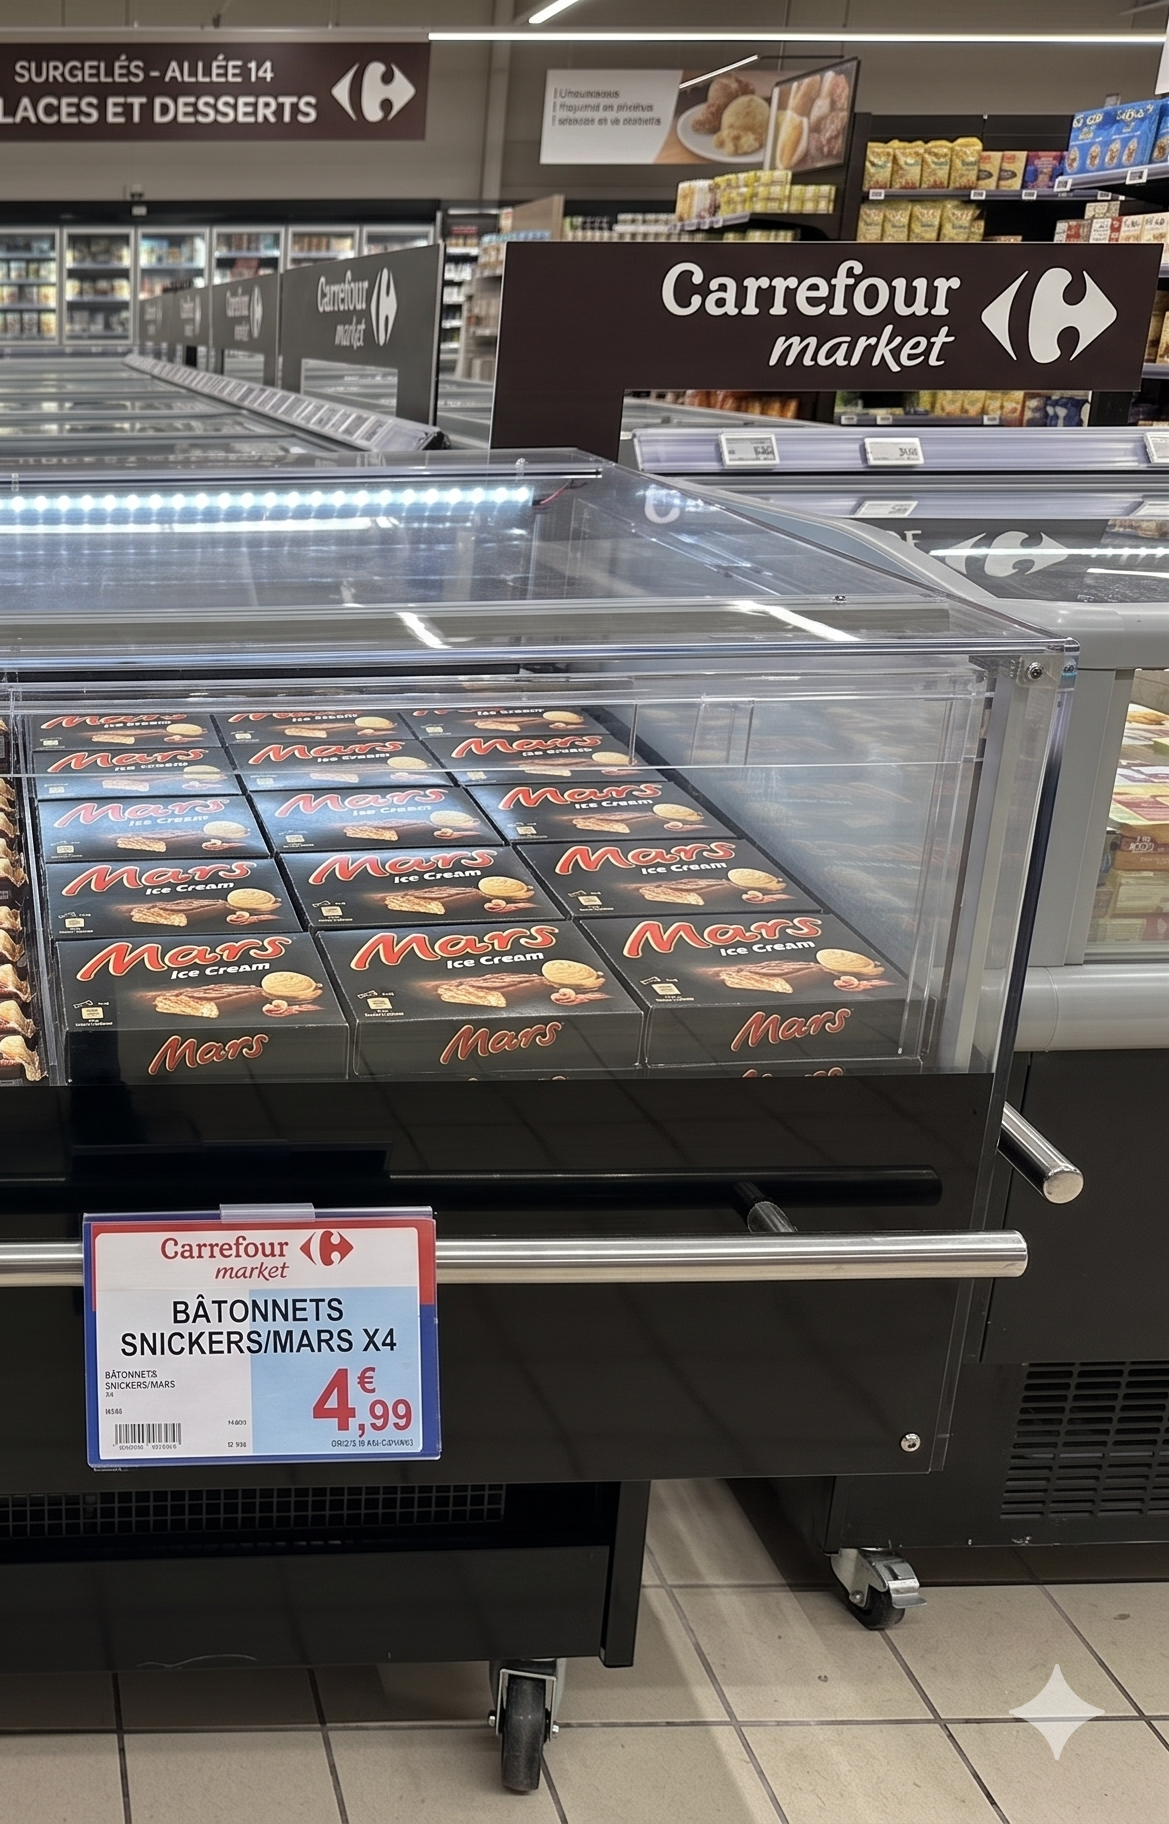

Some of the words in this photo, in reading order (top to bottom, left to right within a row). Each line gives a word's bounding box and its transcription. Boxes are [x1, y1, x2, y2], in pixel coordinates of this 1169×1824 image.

[14, 53, 144, 83] SURGELÉS
[164, 53, 242, 83] ALLÉE
[248, 60, 274, 82] 14
[106, 96, 147, 124] ET
[153, 95, 317, 124] DESSERTS
[317, 269, 368, 313] Carrefour
[662, 260, 960, 316] Carrefour
[335, 315, 365, 350] market
[769, 324, 955, 372] market
[47, 749, 209, 773] Mars
[248, 741, 405, 765] Mars
[452, 736, 603, 758] Mars
[274, 788, 449, 817] Mars
[498, 783, 663, 811] Mars
[54, 800, 225, 828] Mars
[308, 849, 497, 885] Mars
[555, 841, 736, 875] Mars
[641, 866, 669, 875] Ice
[671, 861, 727, 872] Cream
[62, 862, 257, 896] Mars
[145, 885, 171, 895] Ice
[176, 882, 234, 892] Cream
[394, 875, 420, 884] Ice
[423, 869, 481, 881] Cream
[350, 925, 559, 971] Mars
[623, 917, 822, 958] Mars
[720, 946, 749, 956] Ice
[752, 940, 815, 953] Cream
[76, 936, 292, 981] Mars
[170, 968, 199, 980] Ice
[204, 962, 270, 976] Cream
[447, 958, 475, 969] Ice
[480, 952, 544, 966] Cream
[440, 1021, 562, 1064] Mars
[730, 1007, 852, 1051] Mars
[148, 1033, 268, 1075] Mars
[160, 1235, 289, 1261] Carrefour
[215, 1262, 290, 1281] market
[172, 1294, 344, 1325] BÂTONNETS
[120, 1328, 353, 1357] SNICKERS/MARS
[362, 1328, 397, 1352] X4
[105, 1380, 176, 1390] SNICKERS/MARS
